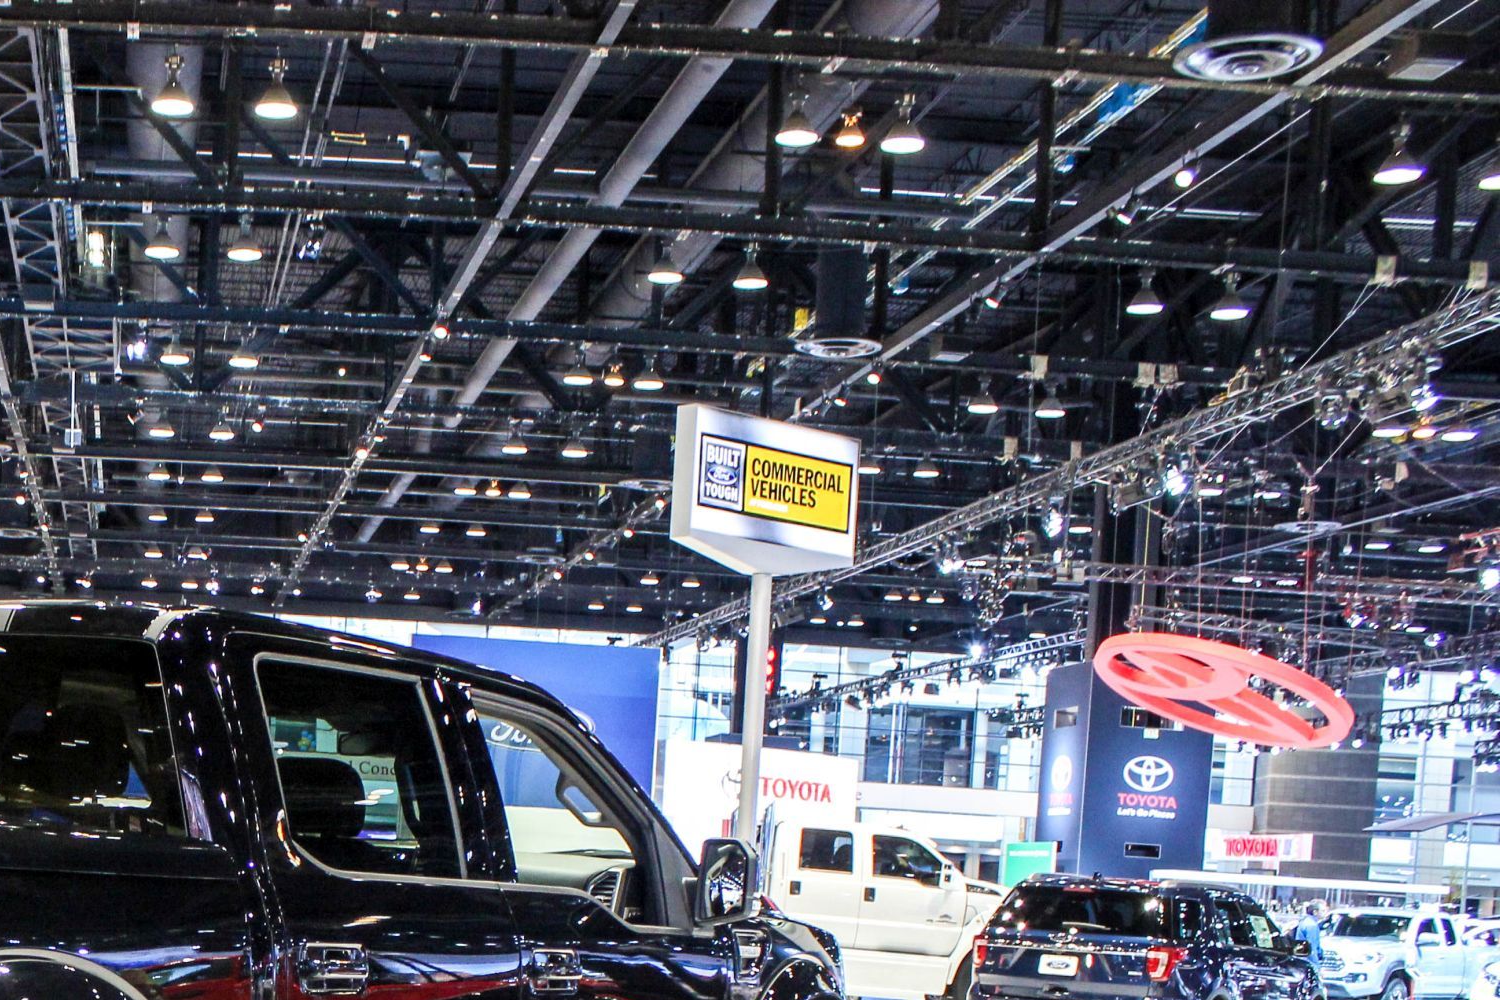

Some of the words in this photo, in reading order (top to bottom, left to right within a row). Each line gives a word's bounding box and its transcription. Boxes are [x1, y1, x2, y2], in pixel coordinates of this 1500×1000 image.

[706, 444, 740, 469] BUILT
[752, 458, 844, 494] COMMERCIAL
[705, 481, 738, 502] TOUGH
[751, 478, 816, 508] VEHICLES
[759, 776, 832, 803] TOYOTA
[1117, 792, 1178, 809] TOYOTA
[1223, 837, 1278, 857] TOYOTA
